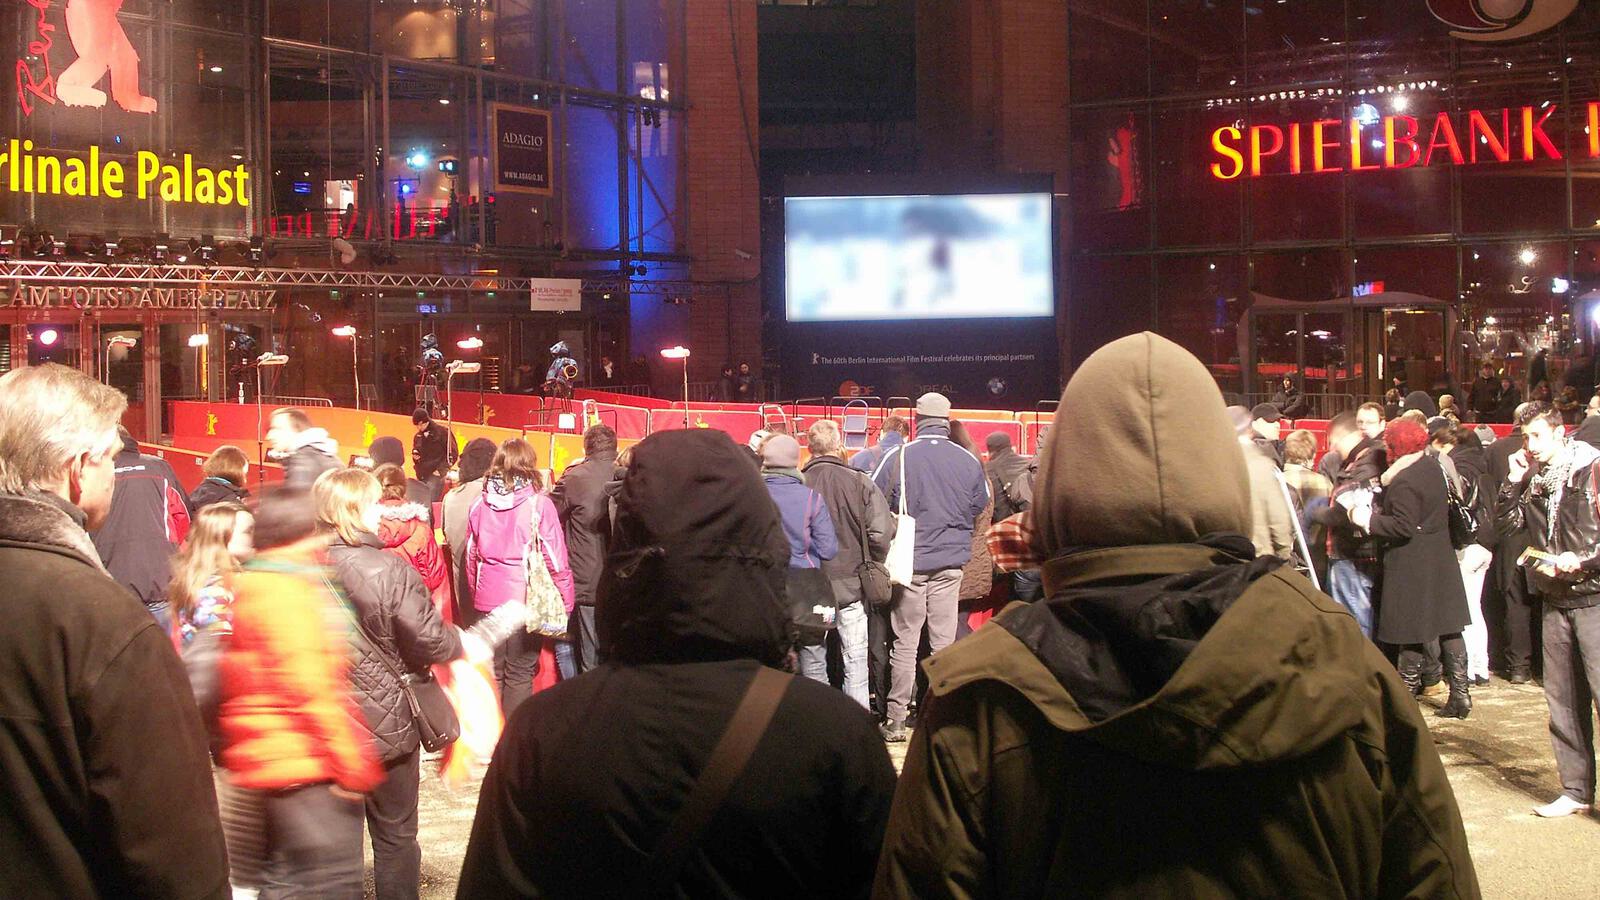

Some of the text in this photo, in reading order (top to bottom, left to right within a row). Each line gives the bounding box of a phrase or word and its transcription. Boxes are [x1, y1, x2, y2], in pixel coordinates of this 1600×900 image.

[503, 132, 543, 147] ADAGIO
[1210, 104, 1562, 180] SPIELBANK
[138, 150, 249, 206] Palast
[9, 285, 54, 308] AM
[58, 285, 209, 309] POTSDAMER
[211, 288, 277, 309] PLATZ
[821, 356, 832, 364] The
[833, 356, 847, 364] 60th
[848, 356, 866, 364] Berlin
[866, 355, 905, 364] International
[906, 355, 920, 363] Film
[920, 354, 943, 363] Festival
[944, 354, 975, 362] celebrates
[983, 353, 1009, 363] principal
[1010, 353, 1035, 363] partners
